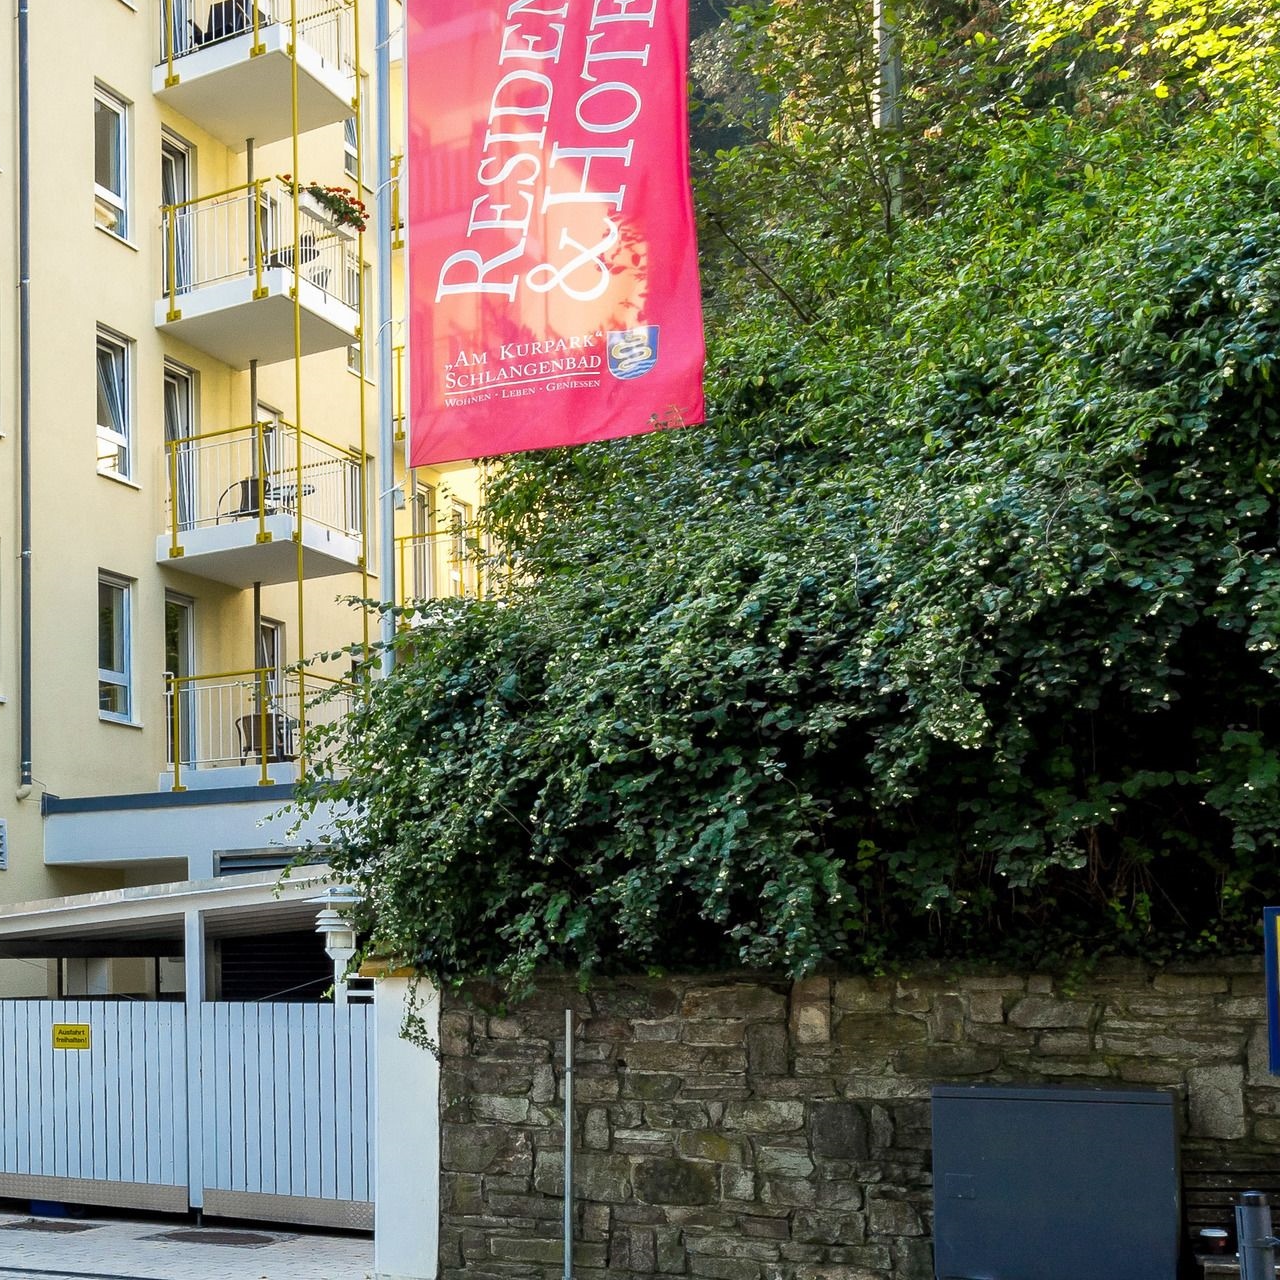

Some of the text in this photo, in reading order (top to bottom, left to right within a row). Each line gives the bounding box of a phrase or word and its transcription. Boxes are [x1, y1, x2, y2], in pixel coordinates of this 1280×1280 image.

[525, 217, 621, 302] &
[444, 355, 602, 389] SCHLANGENBAD
[444, 380, 601, 408] WOHNEN LEBEN GENIESSEN
